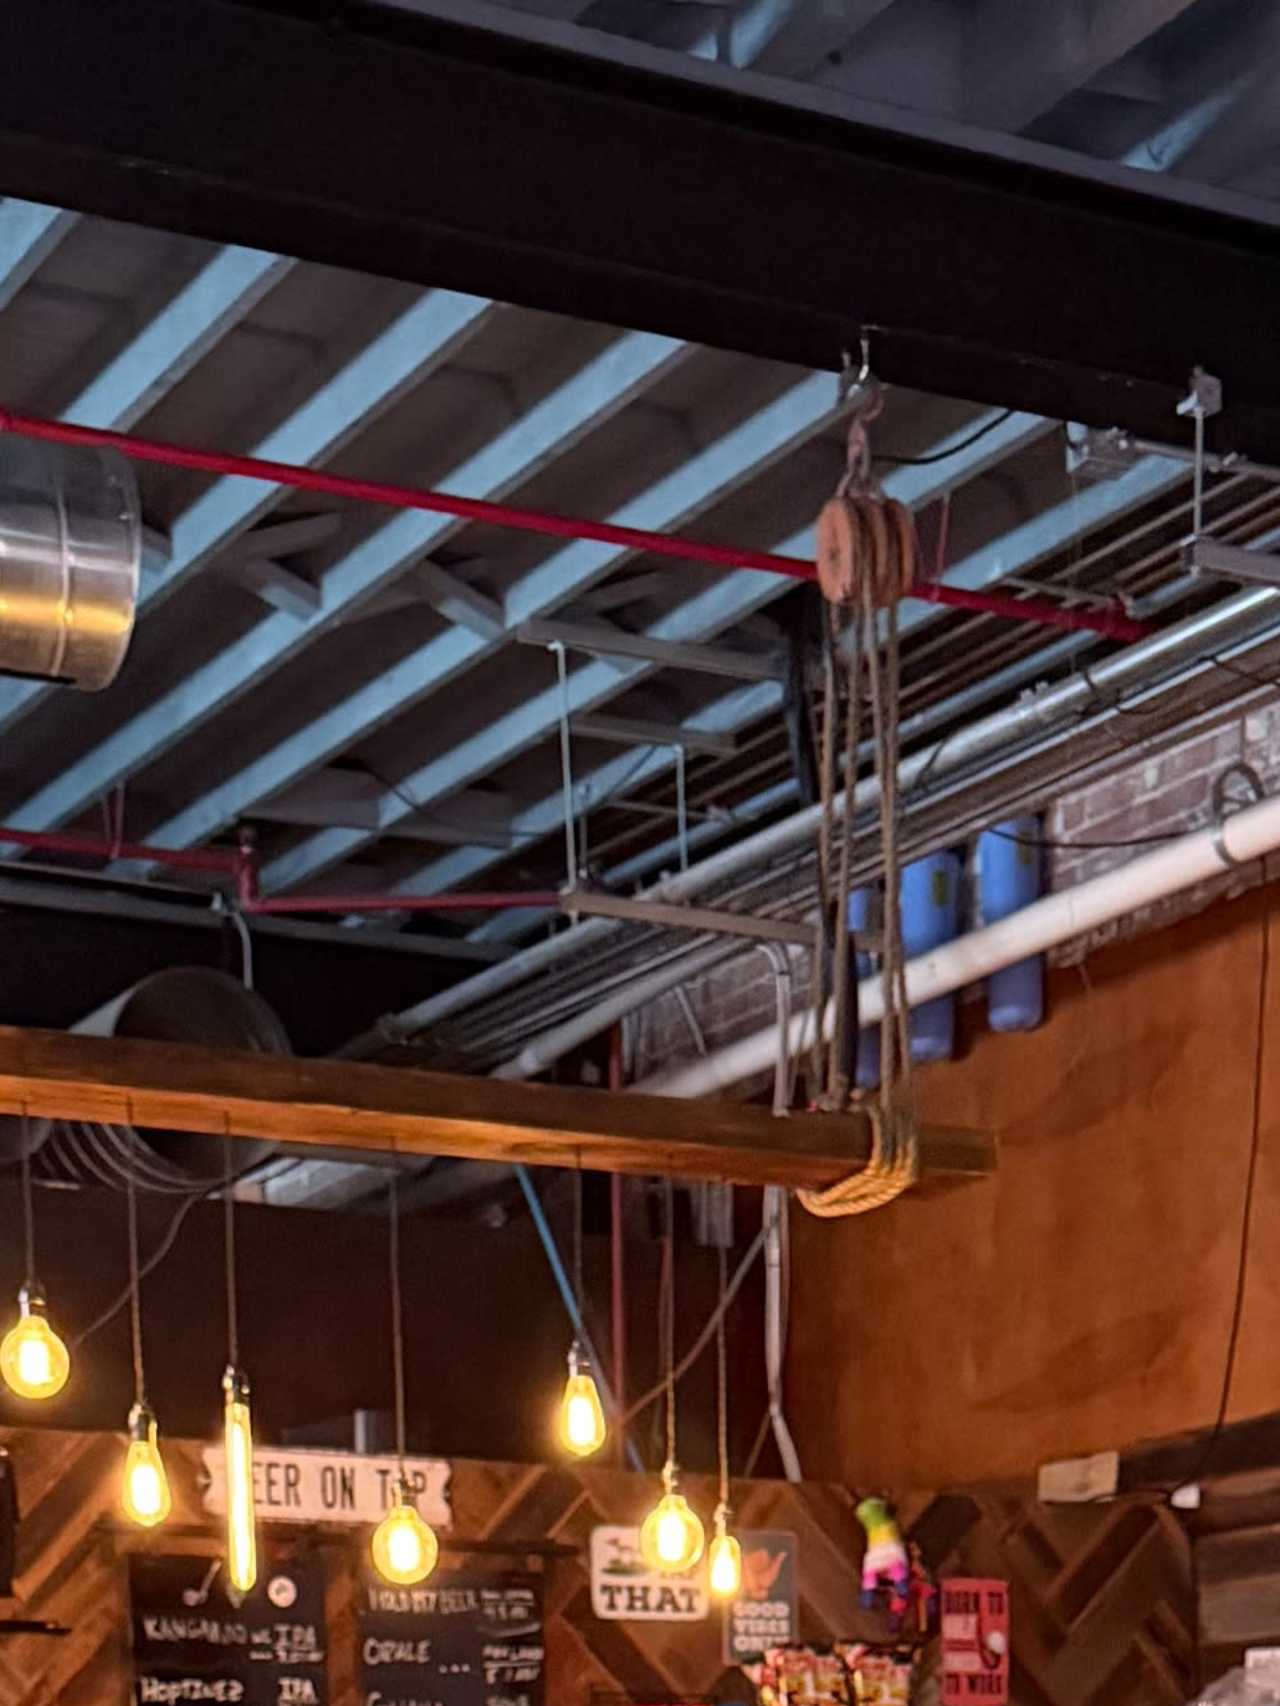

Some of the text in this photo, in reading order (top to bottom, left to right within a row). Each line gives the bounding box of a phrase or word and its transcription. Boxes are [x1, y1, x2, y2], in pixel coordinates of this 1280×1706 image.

[247, 1462, 427, 1509] EER ON TP
[600, 1584, 700, 1613] THAT
